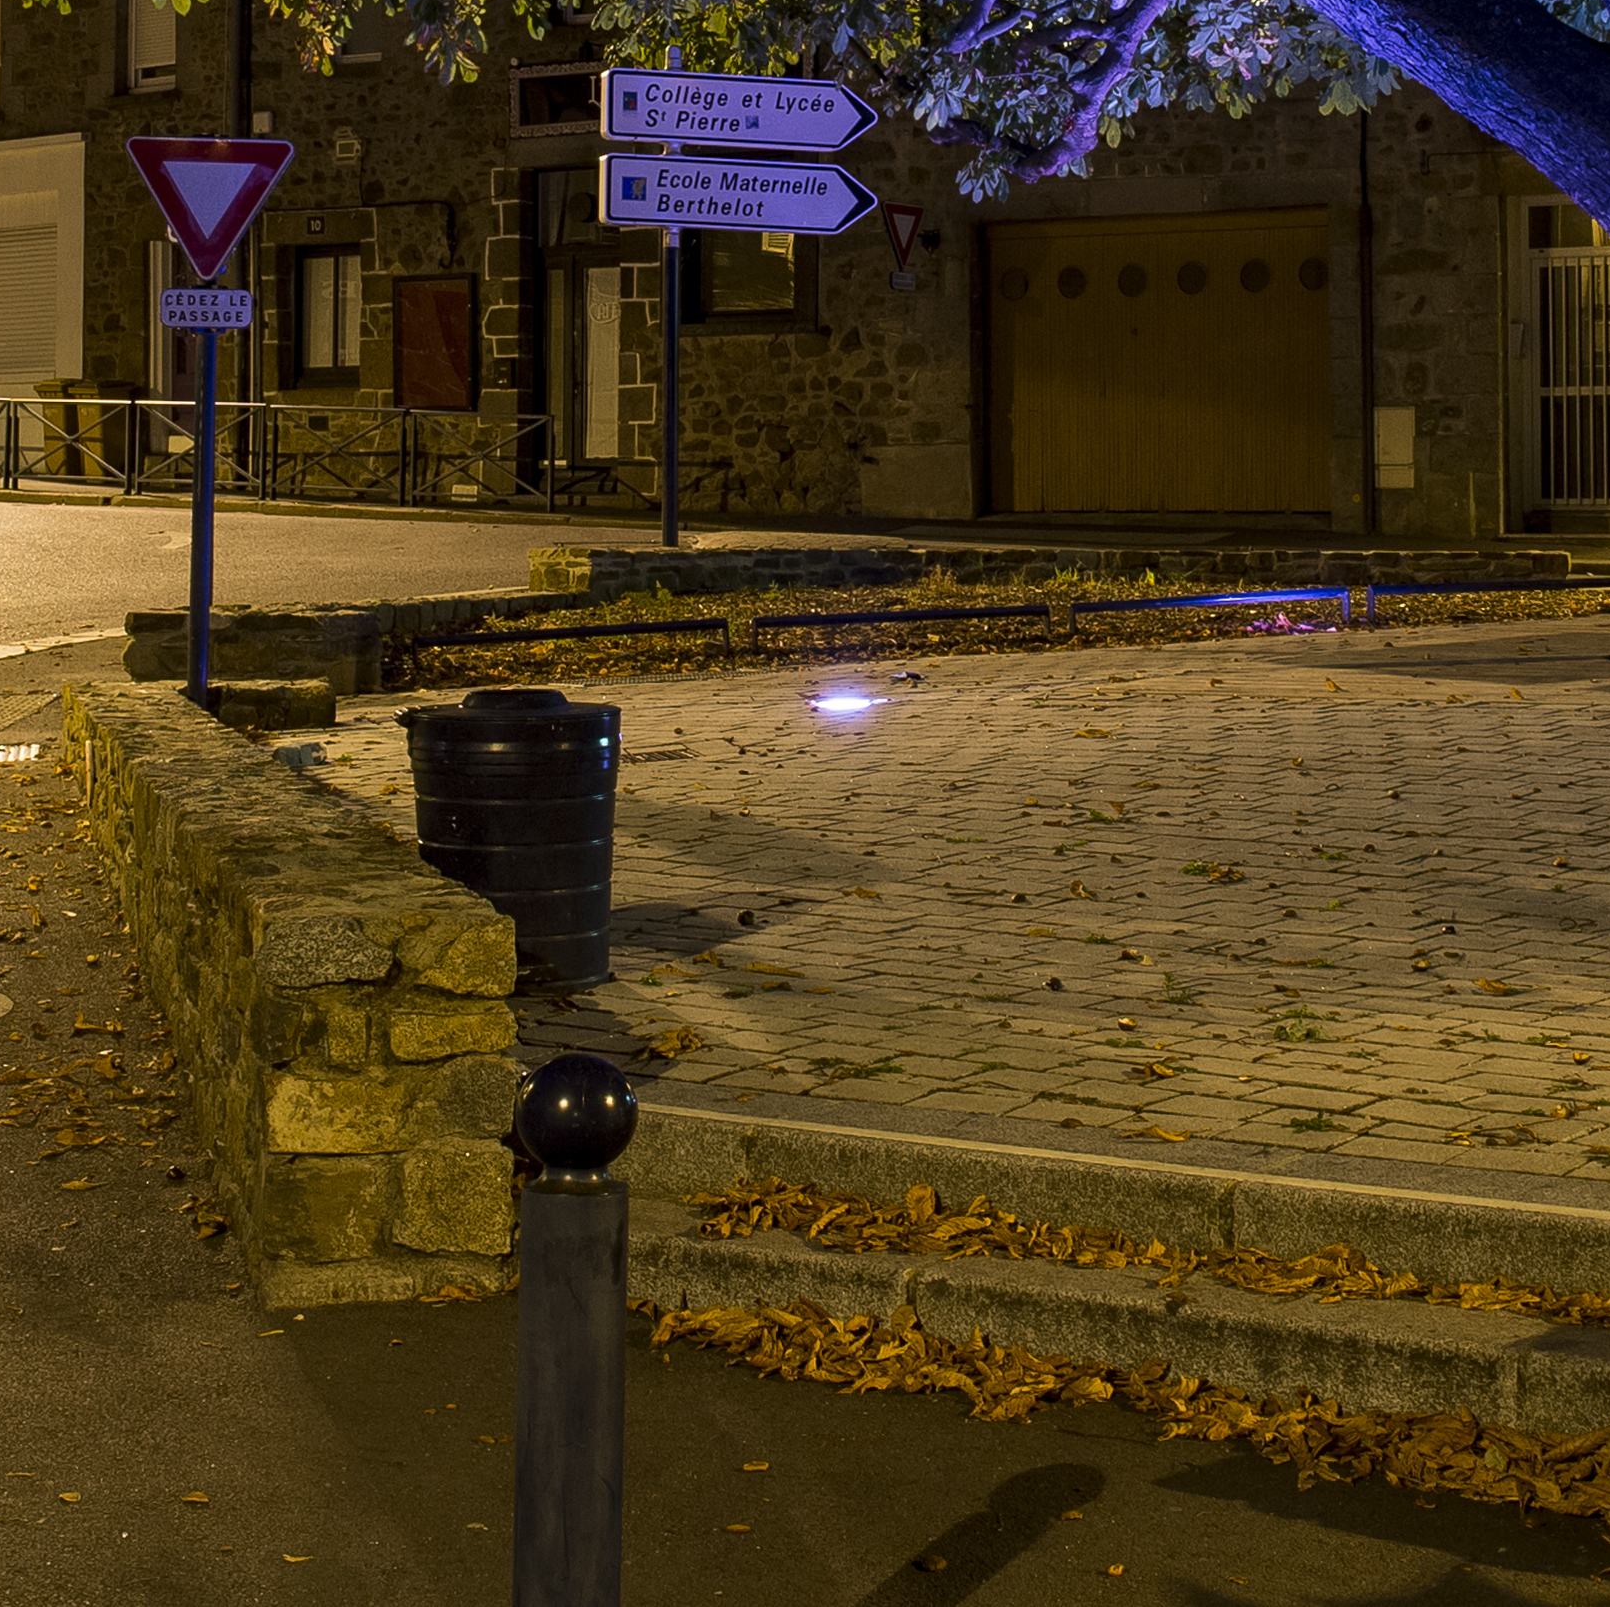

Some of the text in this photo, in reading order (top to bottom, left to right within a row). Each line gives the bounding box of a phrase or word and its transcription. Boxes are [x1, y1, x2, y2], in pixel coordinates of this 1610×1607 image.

[645, 83, 836, 115] Collège et Lycée
[645, 108, 741, 133] St Pierre
[656, 168, 828, 196] Ecole Maternelle
[656, 194, 765, 218] Berthelot
[309, 220, 321, 232] 10
[164, 292, 248, 307] CÉDEZ LE
[168, 310, 244, 323] PASSAGE
